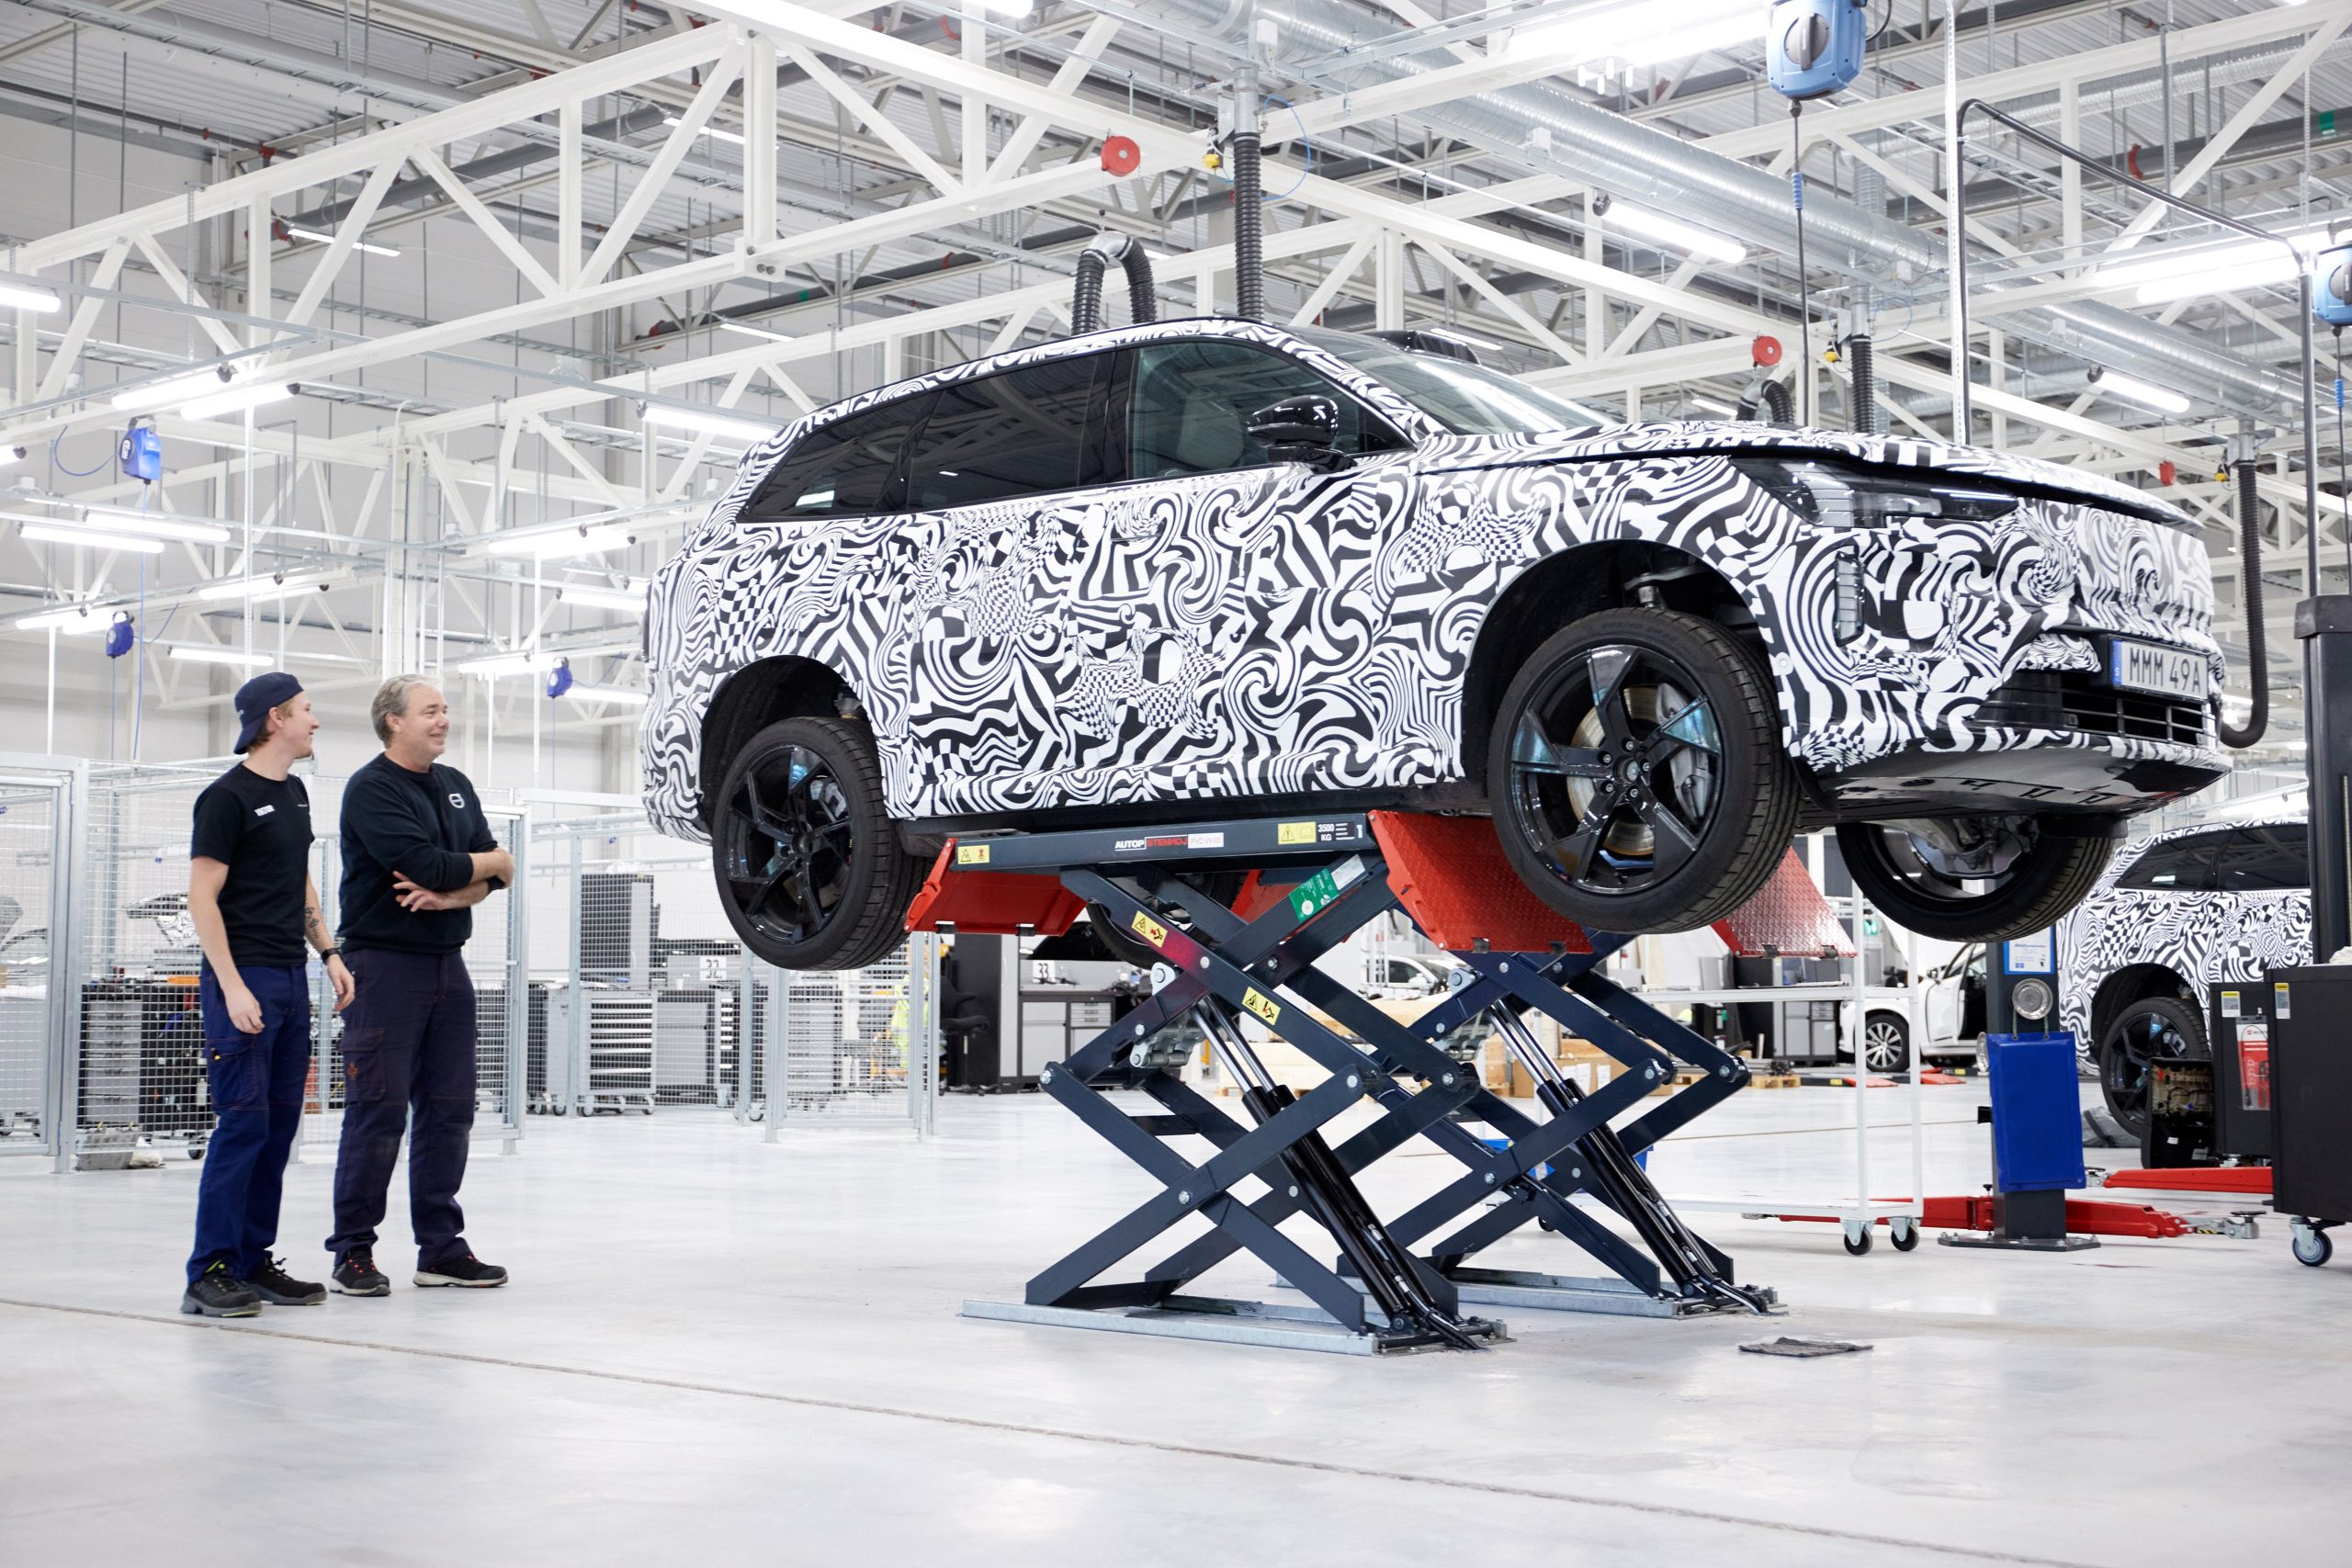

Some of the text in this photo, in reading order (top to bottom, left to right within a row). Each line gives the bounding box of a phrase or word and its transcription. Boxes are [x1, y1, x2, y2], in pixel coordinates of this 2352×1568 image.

[2130, 647, 2201, 694] MMM 49A
[1317, 823, 1335, 832] 3500
[1320, 833, 1332, 841] KG
